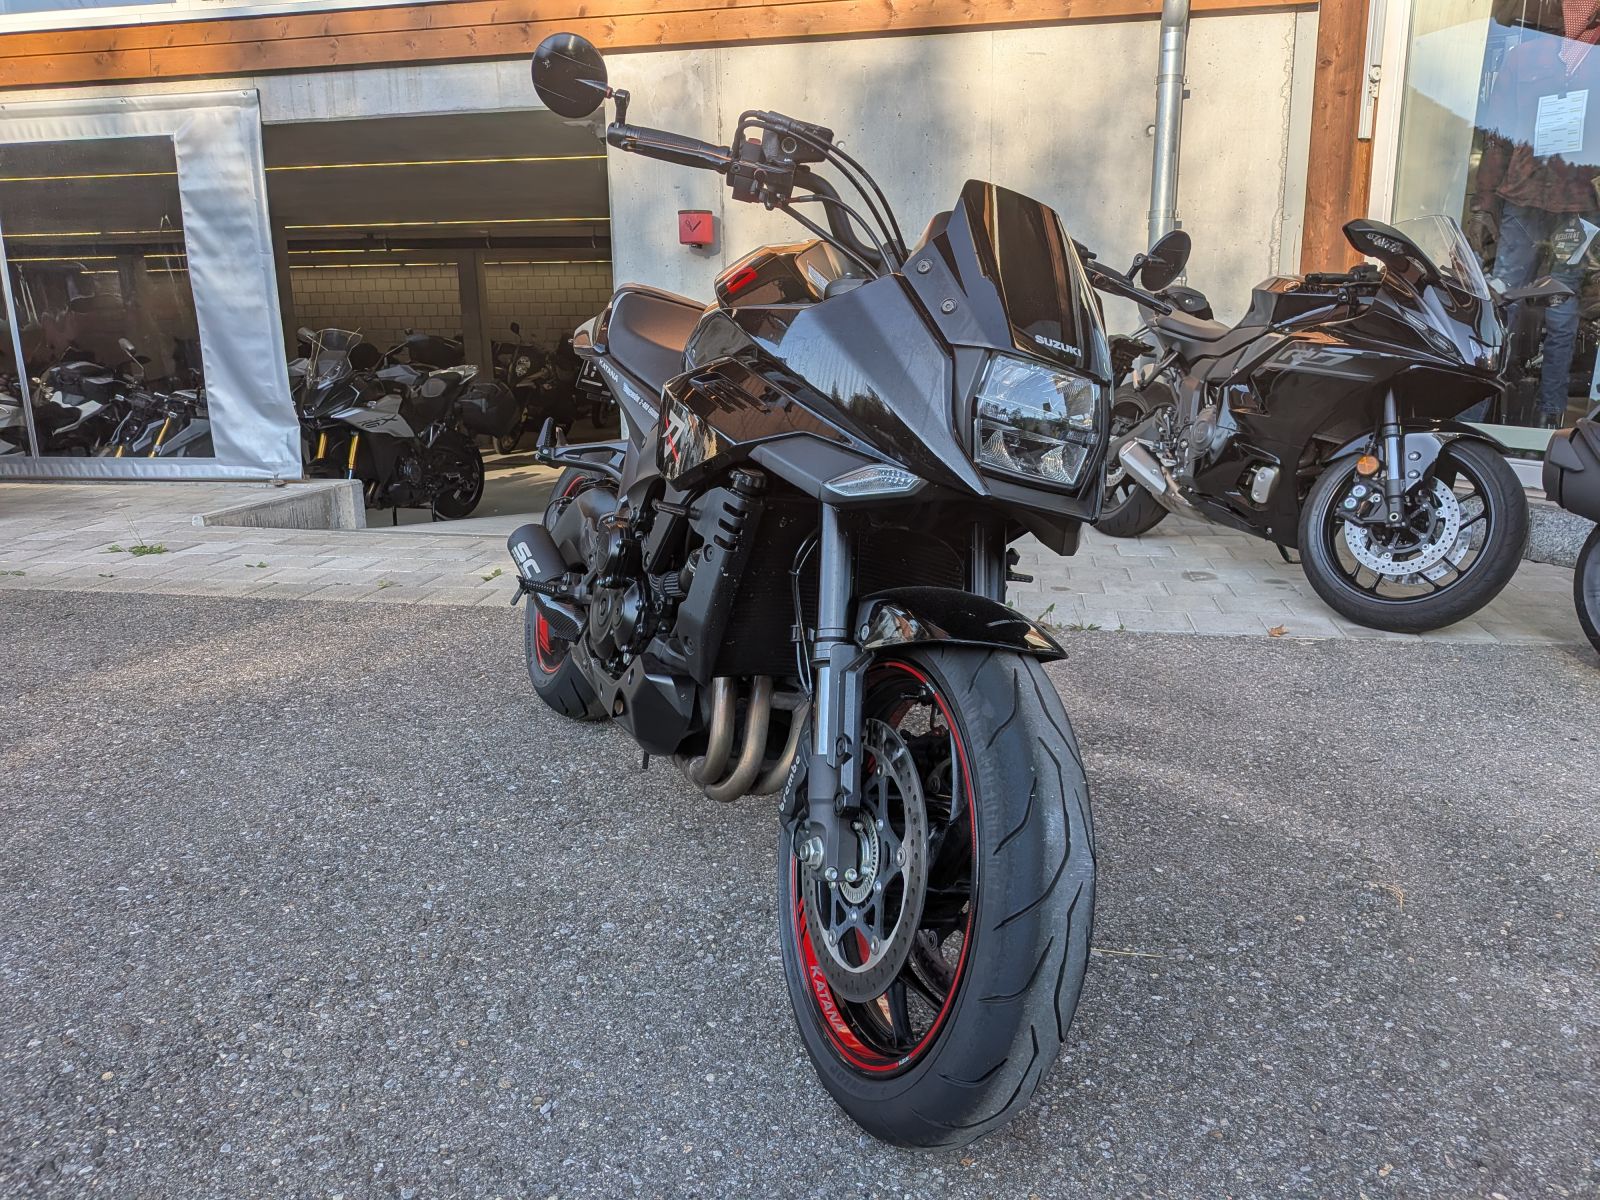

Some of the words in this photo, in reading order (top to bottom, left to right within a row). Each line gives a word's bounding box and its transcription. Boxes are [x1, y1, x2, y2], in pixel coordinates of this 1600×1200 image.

[1034, 334, 1082, 358] SUZUKI
[599, 358, 618, 383] KATANA
[511, 541, 541, 579] SC
[779, 755, 801, 812] brembo
[810, 965, 844, 1032] KATANA
